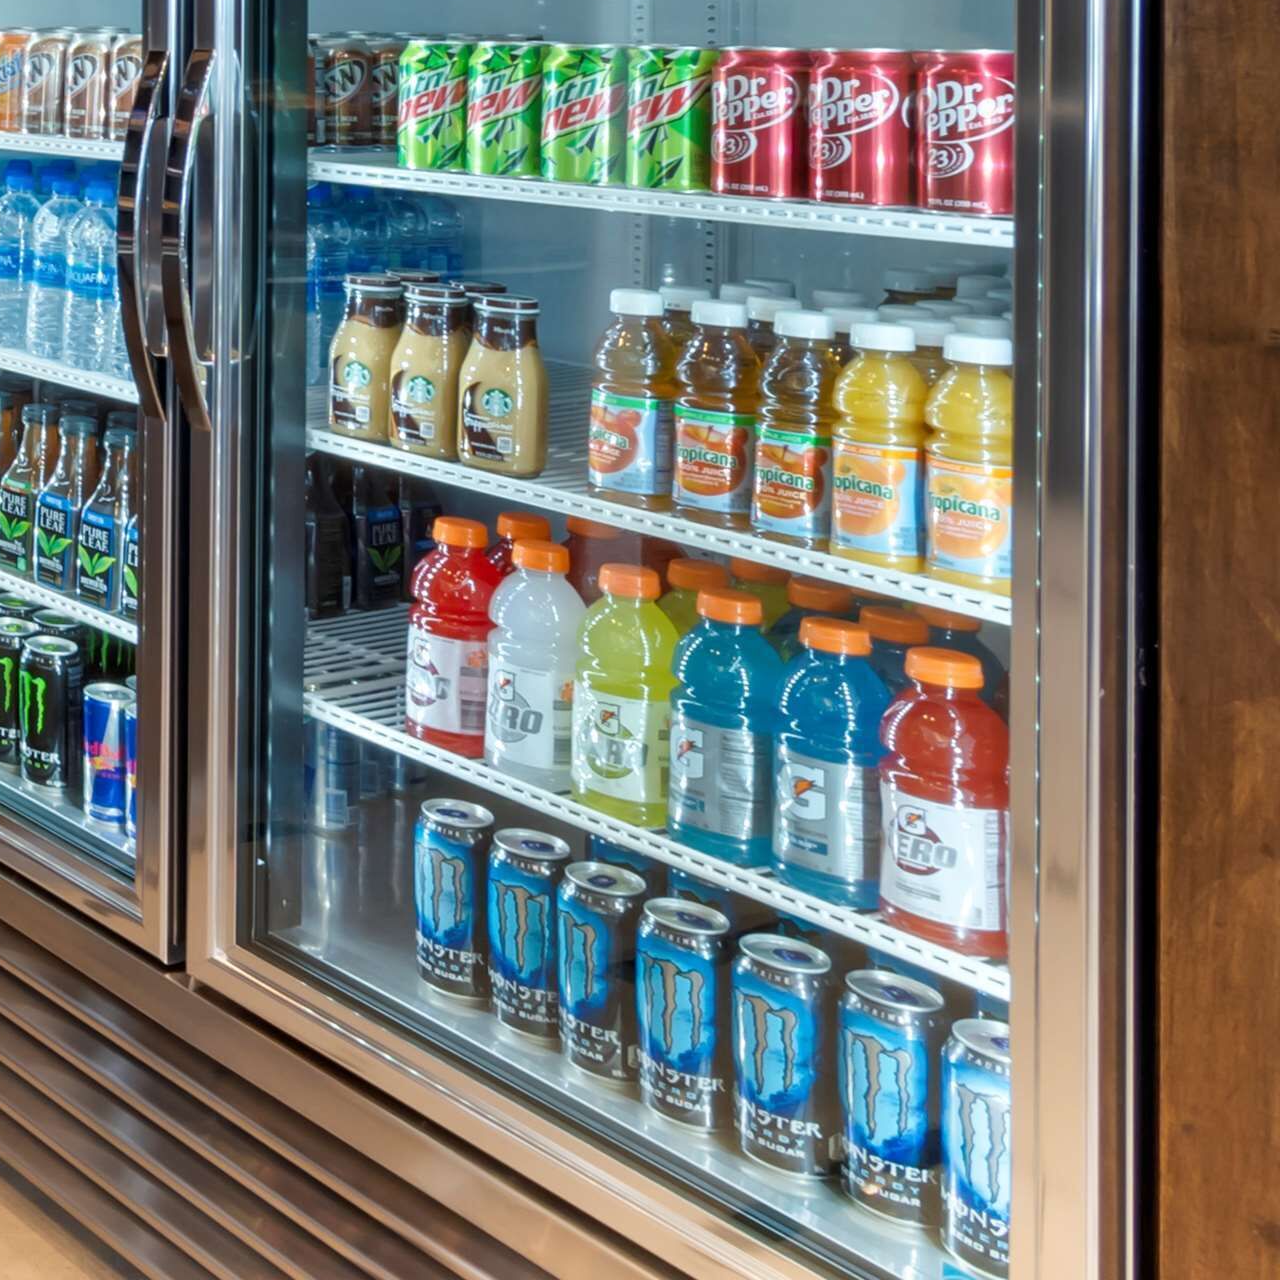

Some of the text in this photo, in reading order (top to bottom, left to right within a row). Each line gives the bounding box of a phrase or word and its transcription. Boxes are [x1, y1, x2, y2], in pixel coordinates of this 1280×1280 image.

[727, 75, 767, 104] Dr
[821, 77, 861, 105] Dr
[936, 80, 984, 110] Dr
[711, 80, 794, 126] Pepper
[2, 491, 27, 507] PURE
[2, 501, 27, 517] LEAF
[40, 505, 66, 523] PURE
[40, 517, 65, 534] LEAF
[82, 523, 109, 540] PURE
[82, 535, 109, 553] LEAF
[896, 838, 959, 872] ERO
[758, 1136, 806, 1159] SUGAR
